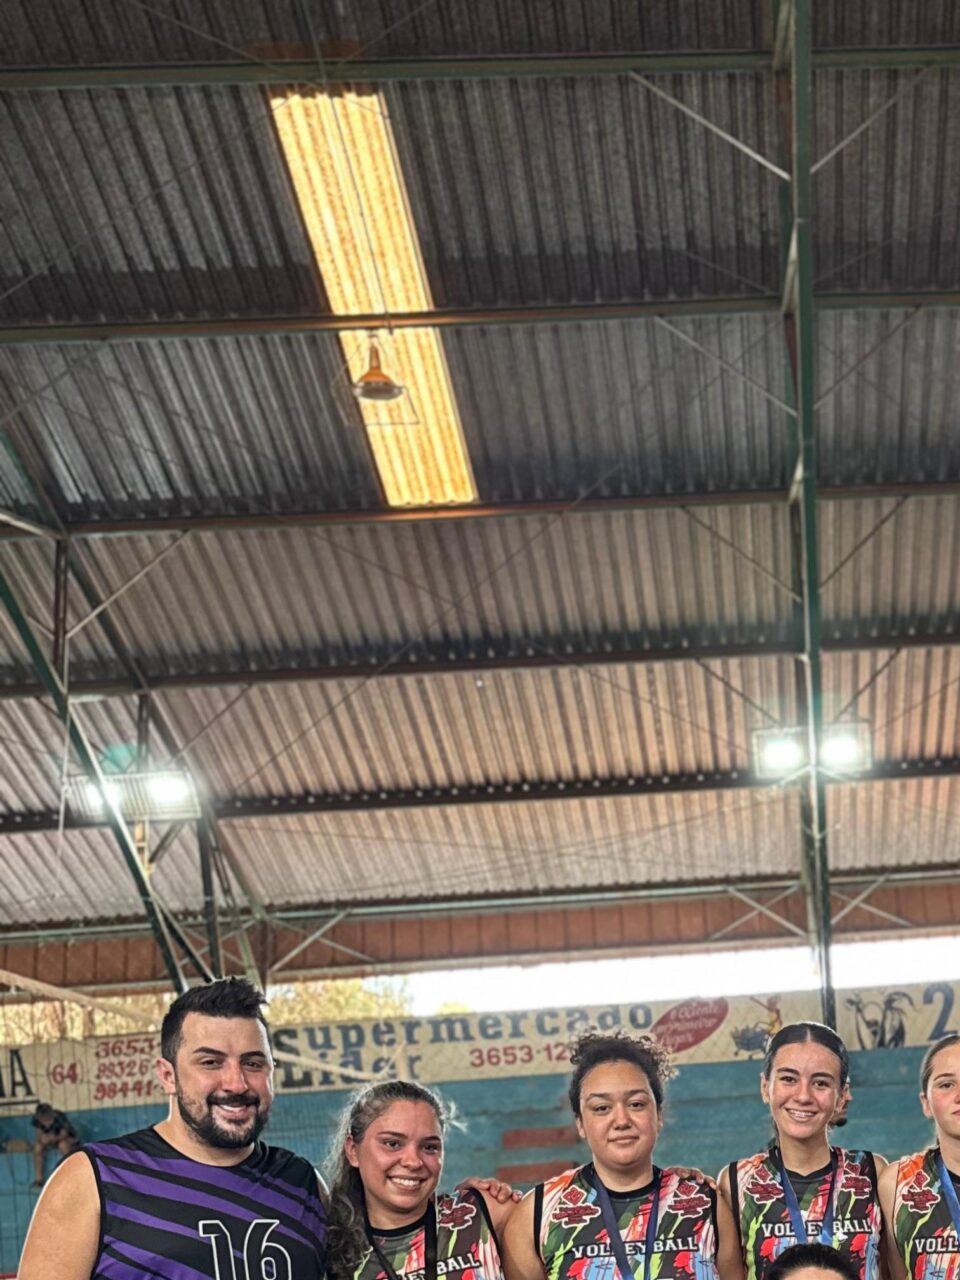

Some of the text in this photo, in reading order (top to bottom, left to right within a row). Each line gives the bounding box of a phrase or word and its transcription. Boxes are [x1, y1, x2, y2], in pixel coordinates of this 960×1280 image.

[922, 983, 958, 1042] 2
[46, 1056, 84, 1088] (64)
[761, 1219, 872, 1238] VOLEBALL
[572, 1237, 701, 1259] VOLEYBALL
